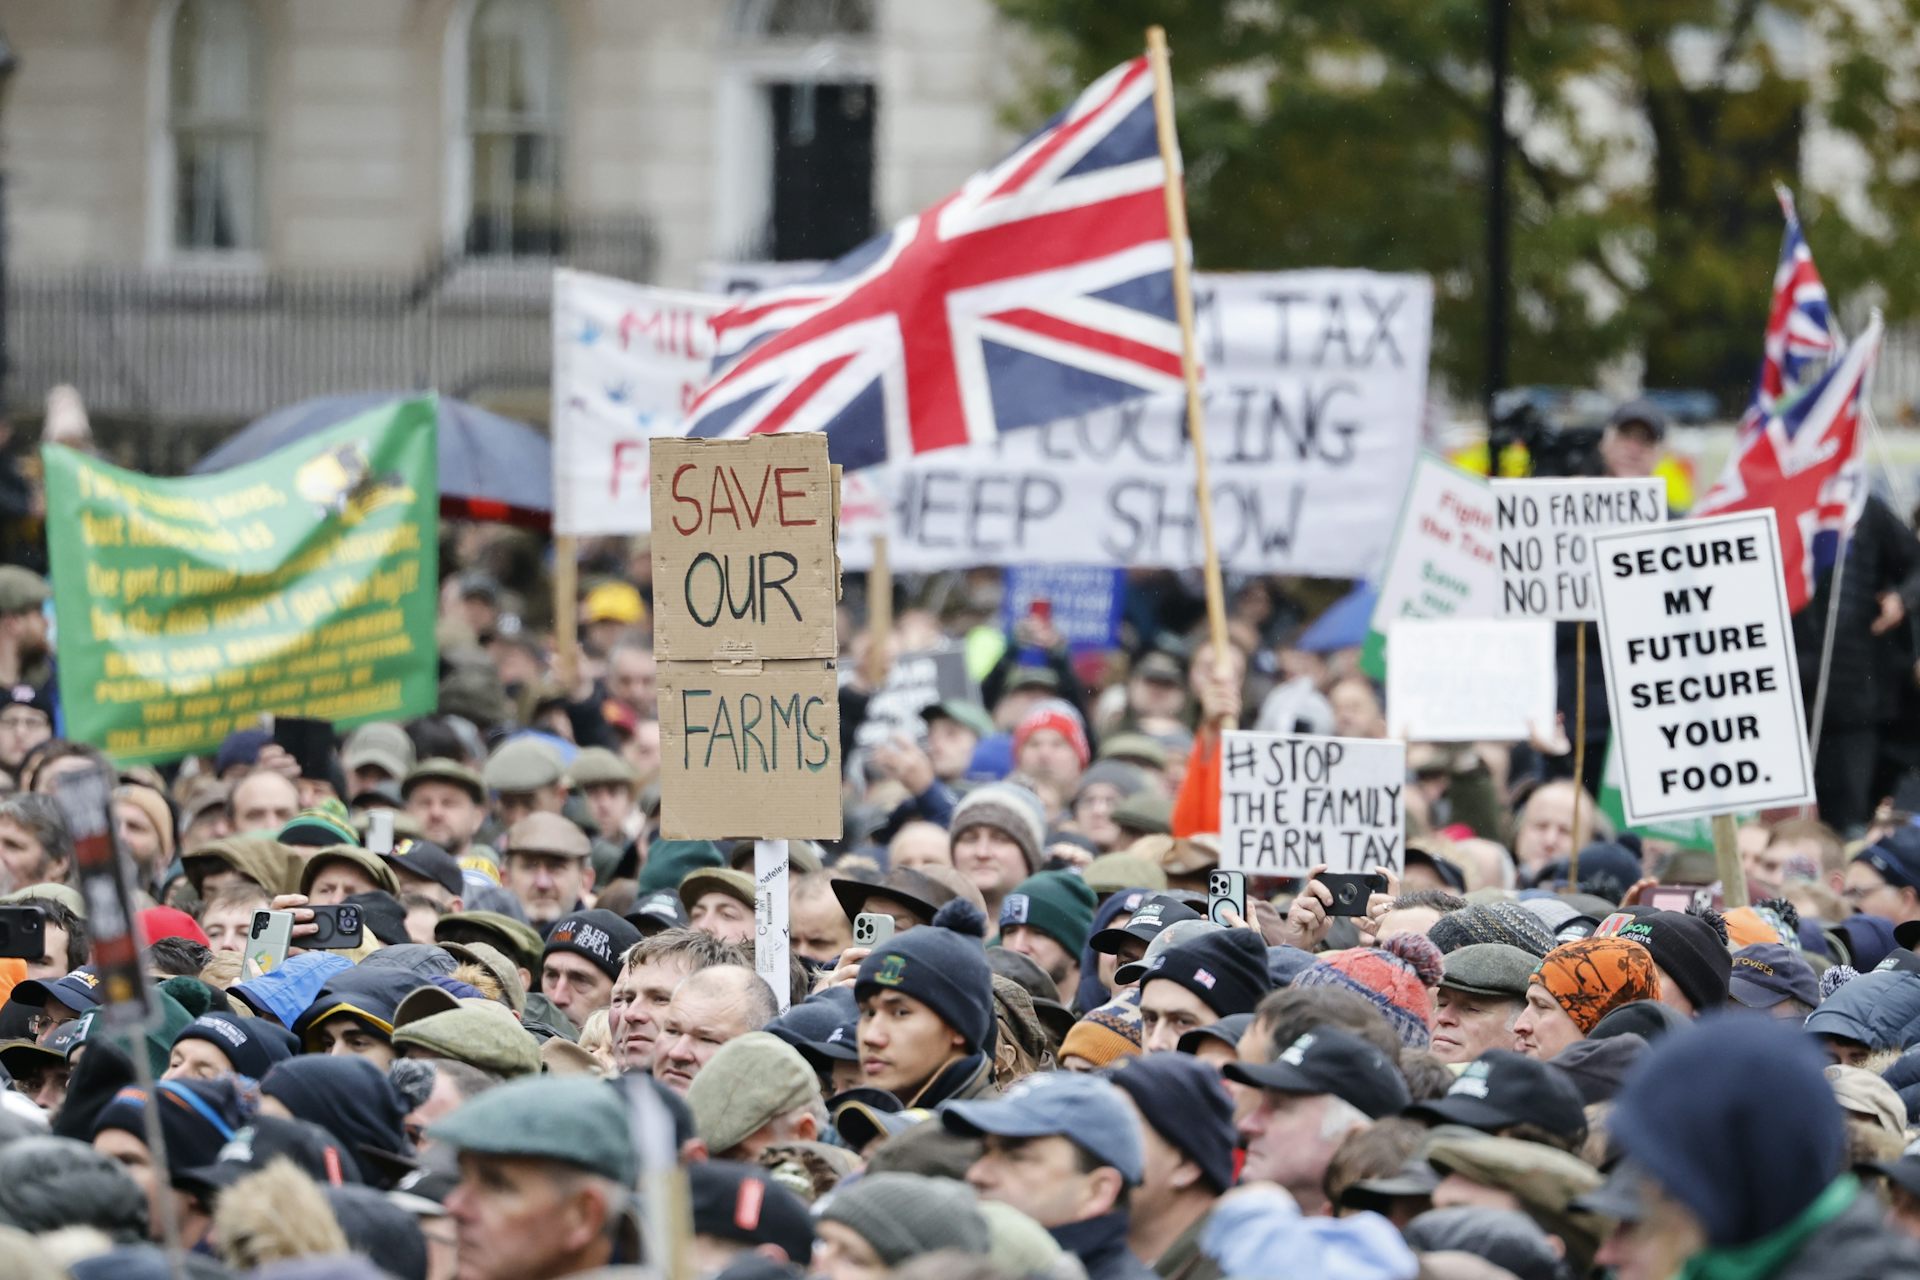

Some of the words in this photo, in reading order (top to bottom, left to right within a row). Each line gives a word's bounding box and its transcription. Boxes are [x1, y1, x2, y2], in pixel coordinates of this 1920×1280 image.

[1262, 290, 1406, 368] TAX
[672, 463, 817, 536] SAVE
[1497, 495, 1538, 530] NO
[1550, 488, 1660, 526] FARMERS
[1500, 536, 1542, 572] NO
[1612, 536, 1758, 578] SECURE
[685, 551, 803, 628] OUR
[1503, 579, 1547, 614] NO
[1663, 585, 1714, 616] MY
[1627, 623, 1768, 665] FUTURE
[1630, 667, 1777, 709] SECURE
[682, 689, 830, 773] FARMS
[1659, 715, 1760, 749] YOUR
[1661, 760, 1772, 794] FOOD.
[1228, 789, 1288, 825] THE
[1302, 784, 1402, 828] FAMILY
[1239, 829, 1327, 868] FARM
[1341, 831, 1399, 873] TAX
